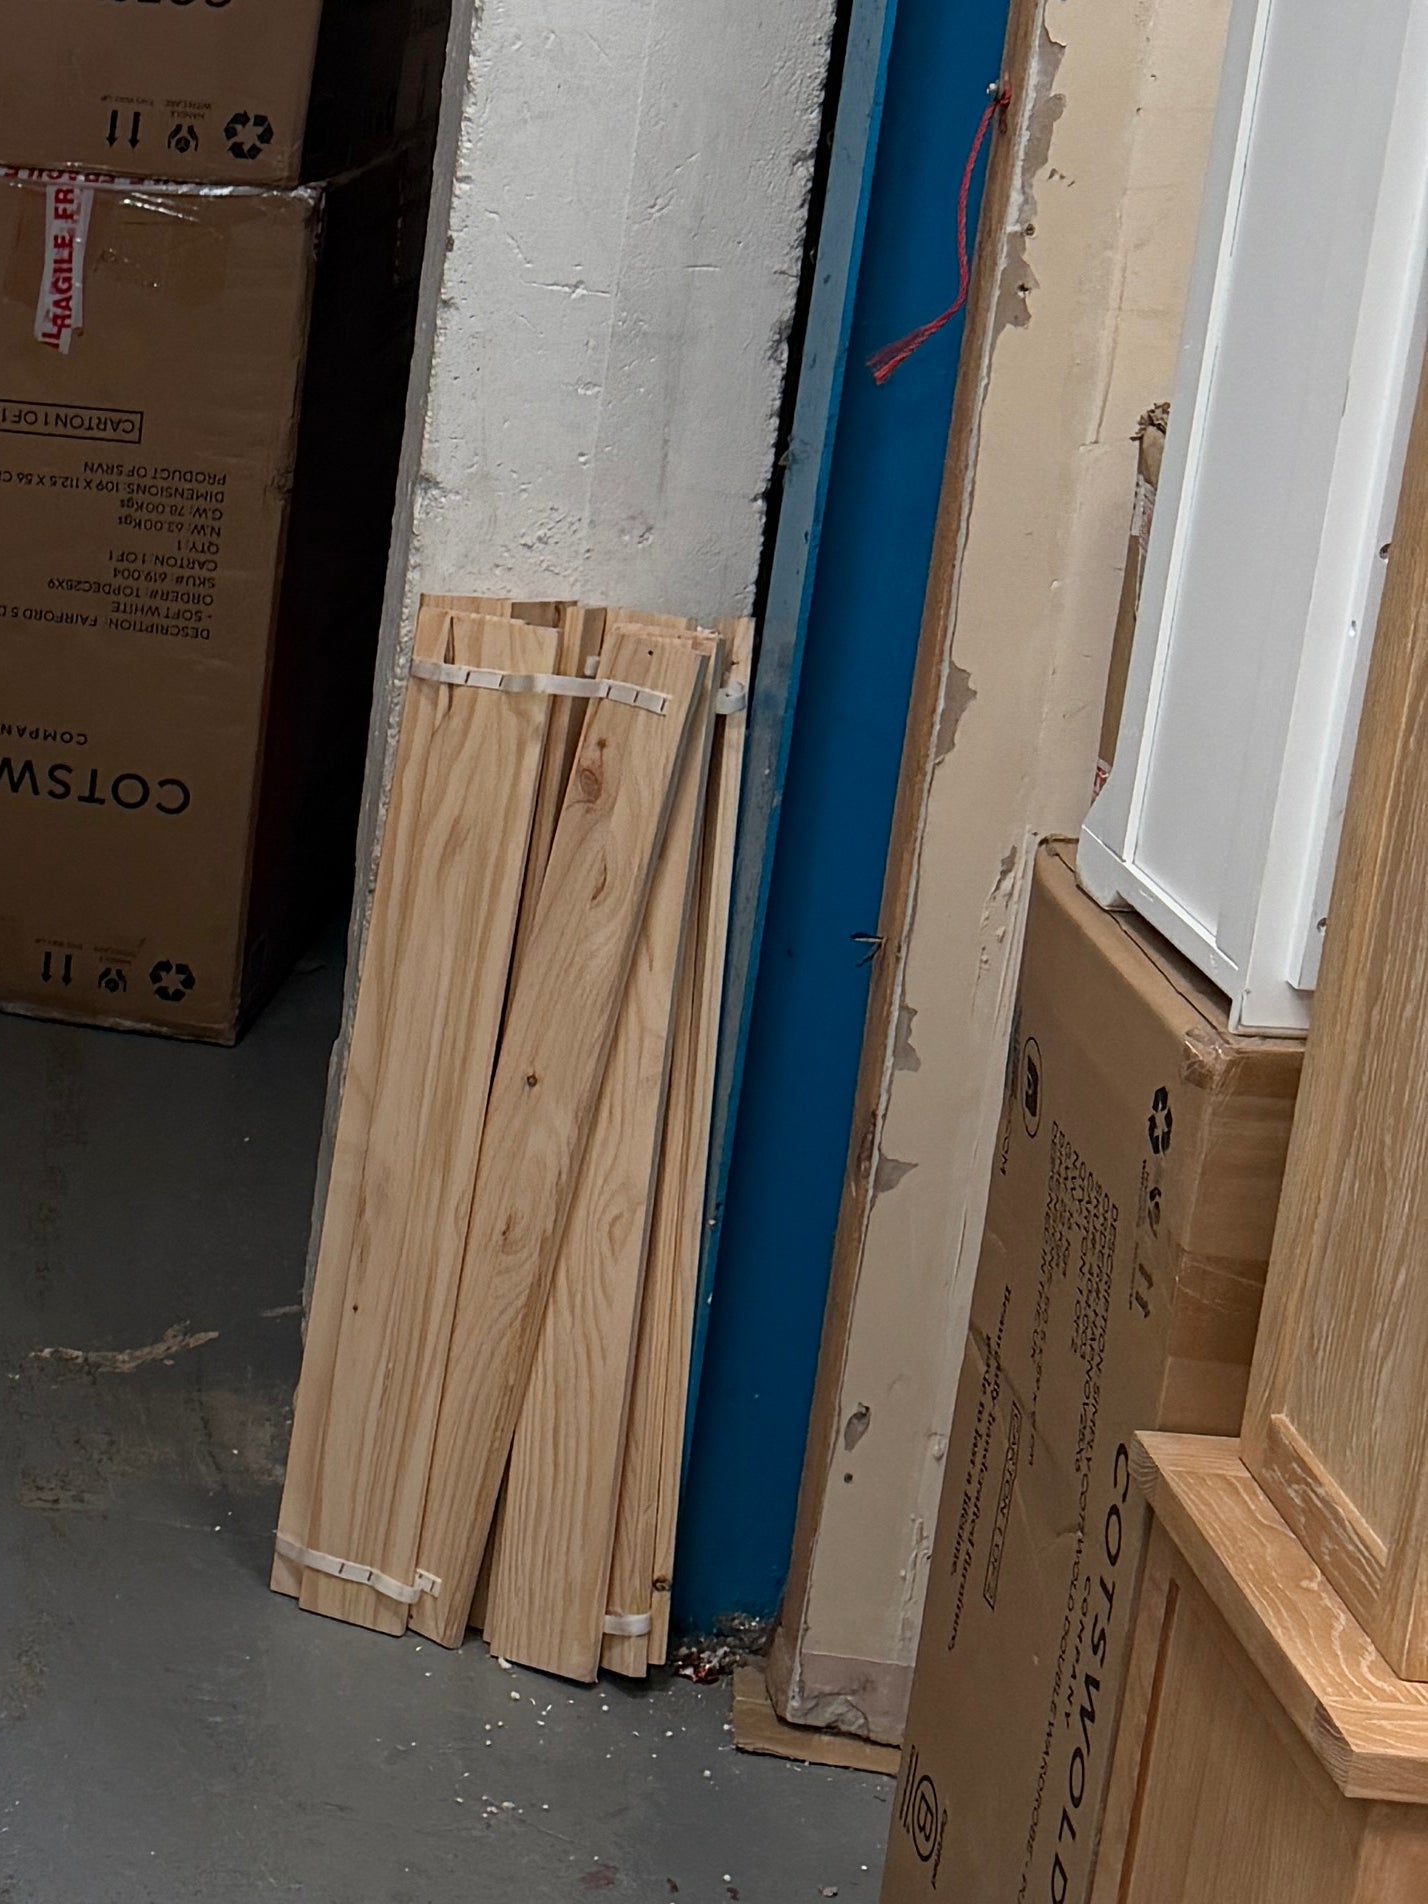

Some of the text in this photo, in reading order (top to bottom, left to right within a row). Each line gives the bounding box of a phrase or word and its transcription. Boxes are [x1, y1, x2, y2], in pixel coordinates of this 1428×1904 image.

[11, 410, 38, 425] OF
[55, 413, 134, 434] CARTON
[17, 472, 32, 485] 56
[36, 474, 45, 486] X
[84, 462, 226, 486] PRODUCT OF SRVN
[83, 478, 92, 490] X
[95, 479, 119, 493] 109
[124, 482, 224, 503] DIMENSIONS:
[116, 551, 137, 563] OF
[11, 606, 18, 617] 5
[23, 608, 97, 626] FAIRFORD
[111, 601, 202, 622] SOFT WHITE
[1064, 1575, 1092, 1729] COMPANY
